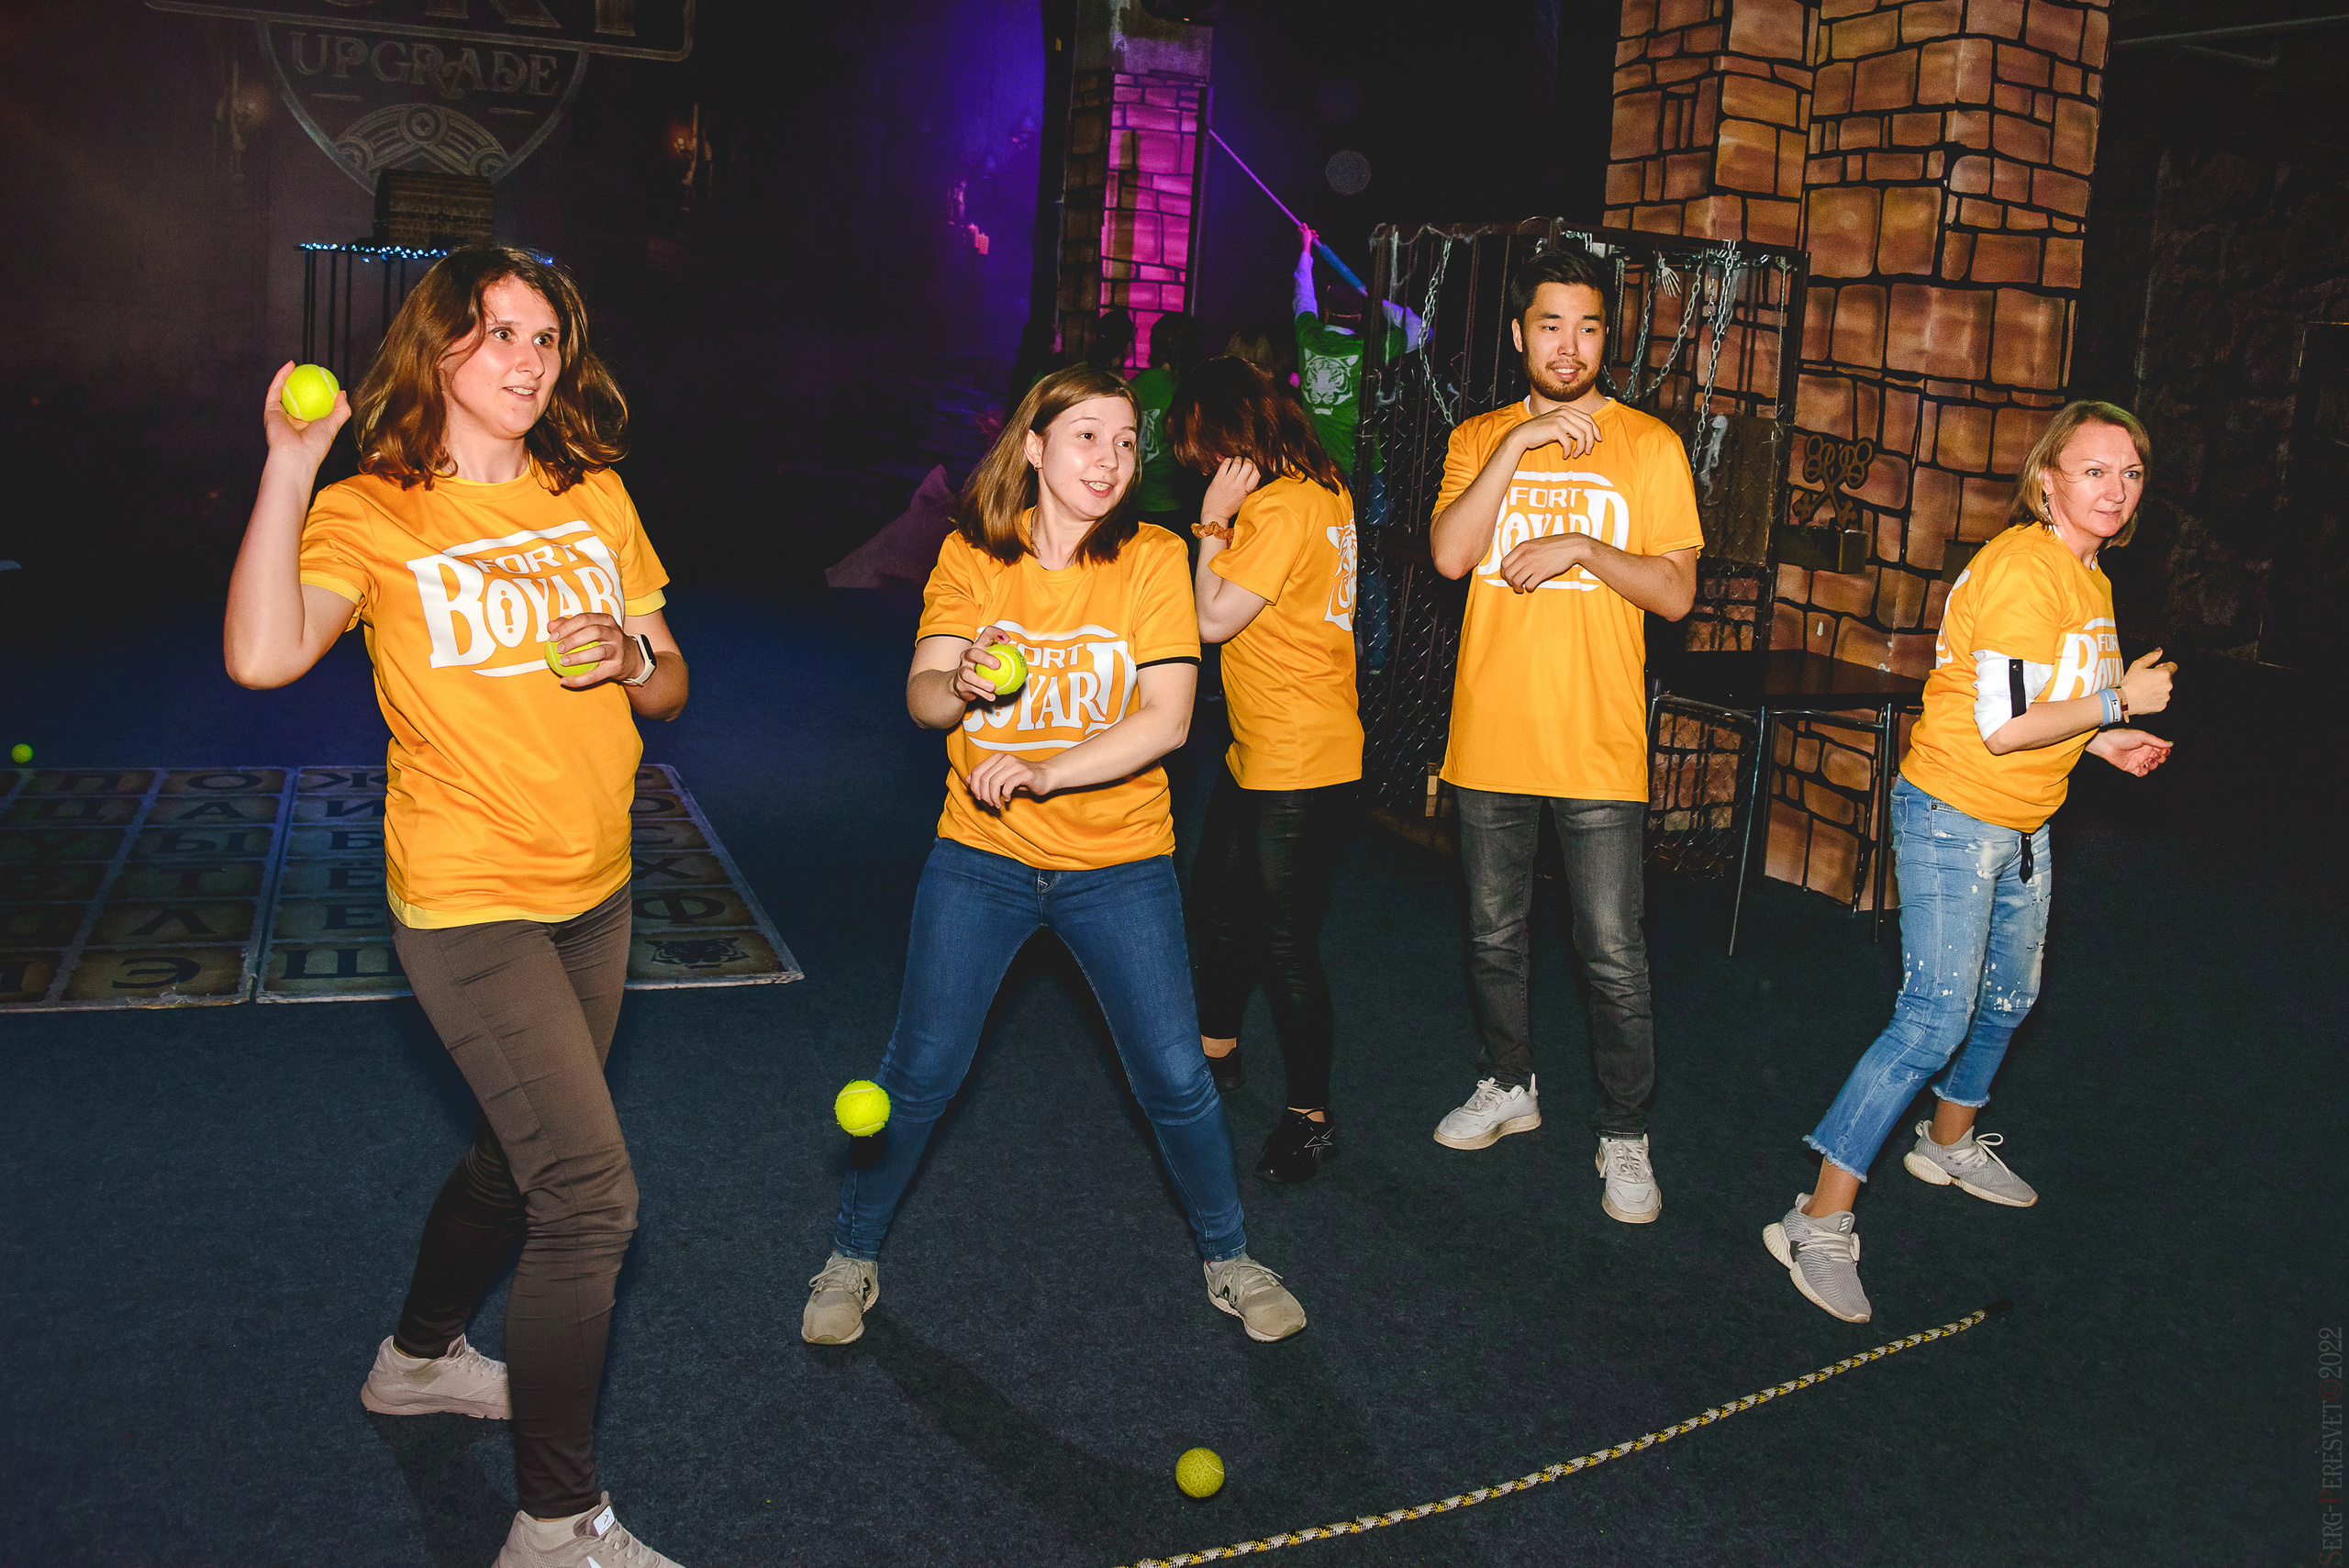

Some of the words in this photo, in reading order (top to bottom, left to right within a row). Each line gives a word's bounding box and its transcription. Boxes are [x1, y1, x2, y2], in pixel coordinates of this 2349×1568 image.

[288, 31, 561, 99] UPGRADE
[1509, 485, 1582, 508] FORT
[473, 543, 580, 574] FORT
[997, 640, 1085, 670] ORT
[963, 639, 1139, 736] YARD
[186, 773, 262, 790] О
[178, 801, 247, 819] А
[157, 831, 248, 853] Ы
[632, 892, 727, 924] Ф
[112, 956, 201, 989] Э
